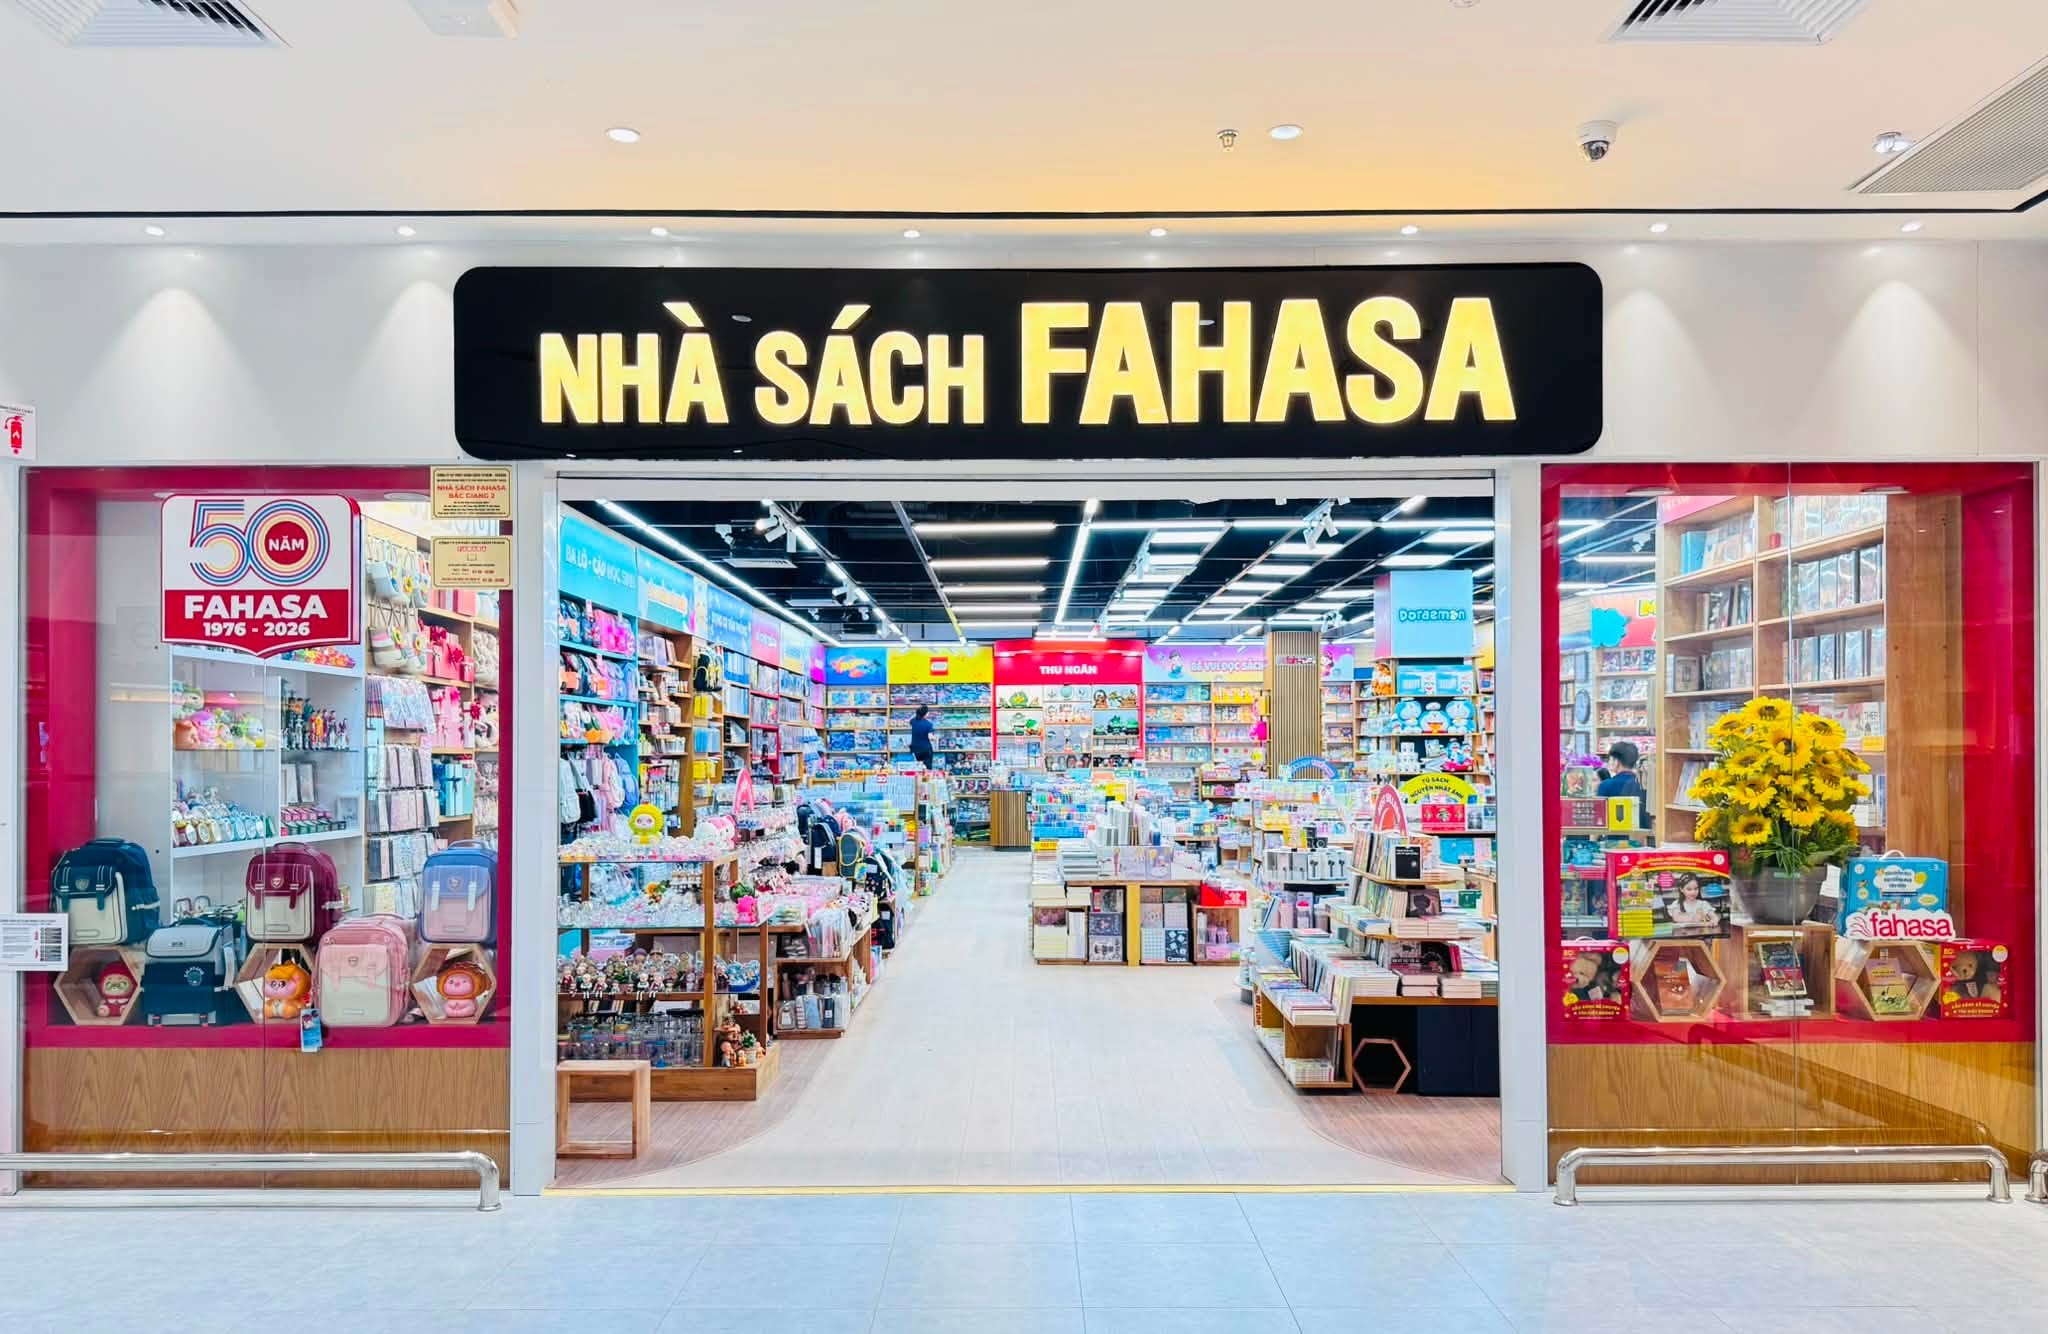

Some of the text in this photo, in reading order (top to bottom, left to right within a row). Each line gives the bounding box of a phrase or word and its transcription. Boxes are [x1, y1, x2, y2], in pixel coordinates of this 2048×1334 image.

[540, 296, 1517, 425] NHÀ SÁCH FAHASA
[190, 499, 330, 587] 50
[268, 535, 305, 552] NĂM
[184, 595, 328, 619] FAHASA
[203, 622, 247, 636] 1976
[263, 622, 311, 636] 2026
[1039, 663, 1097, 675] THU NGÂN
[1870, 912, 1953, 937] fahasa
